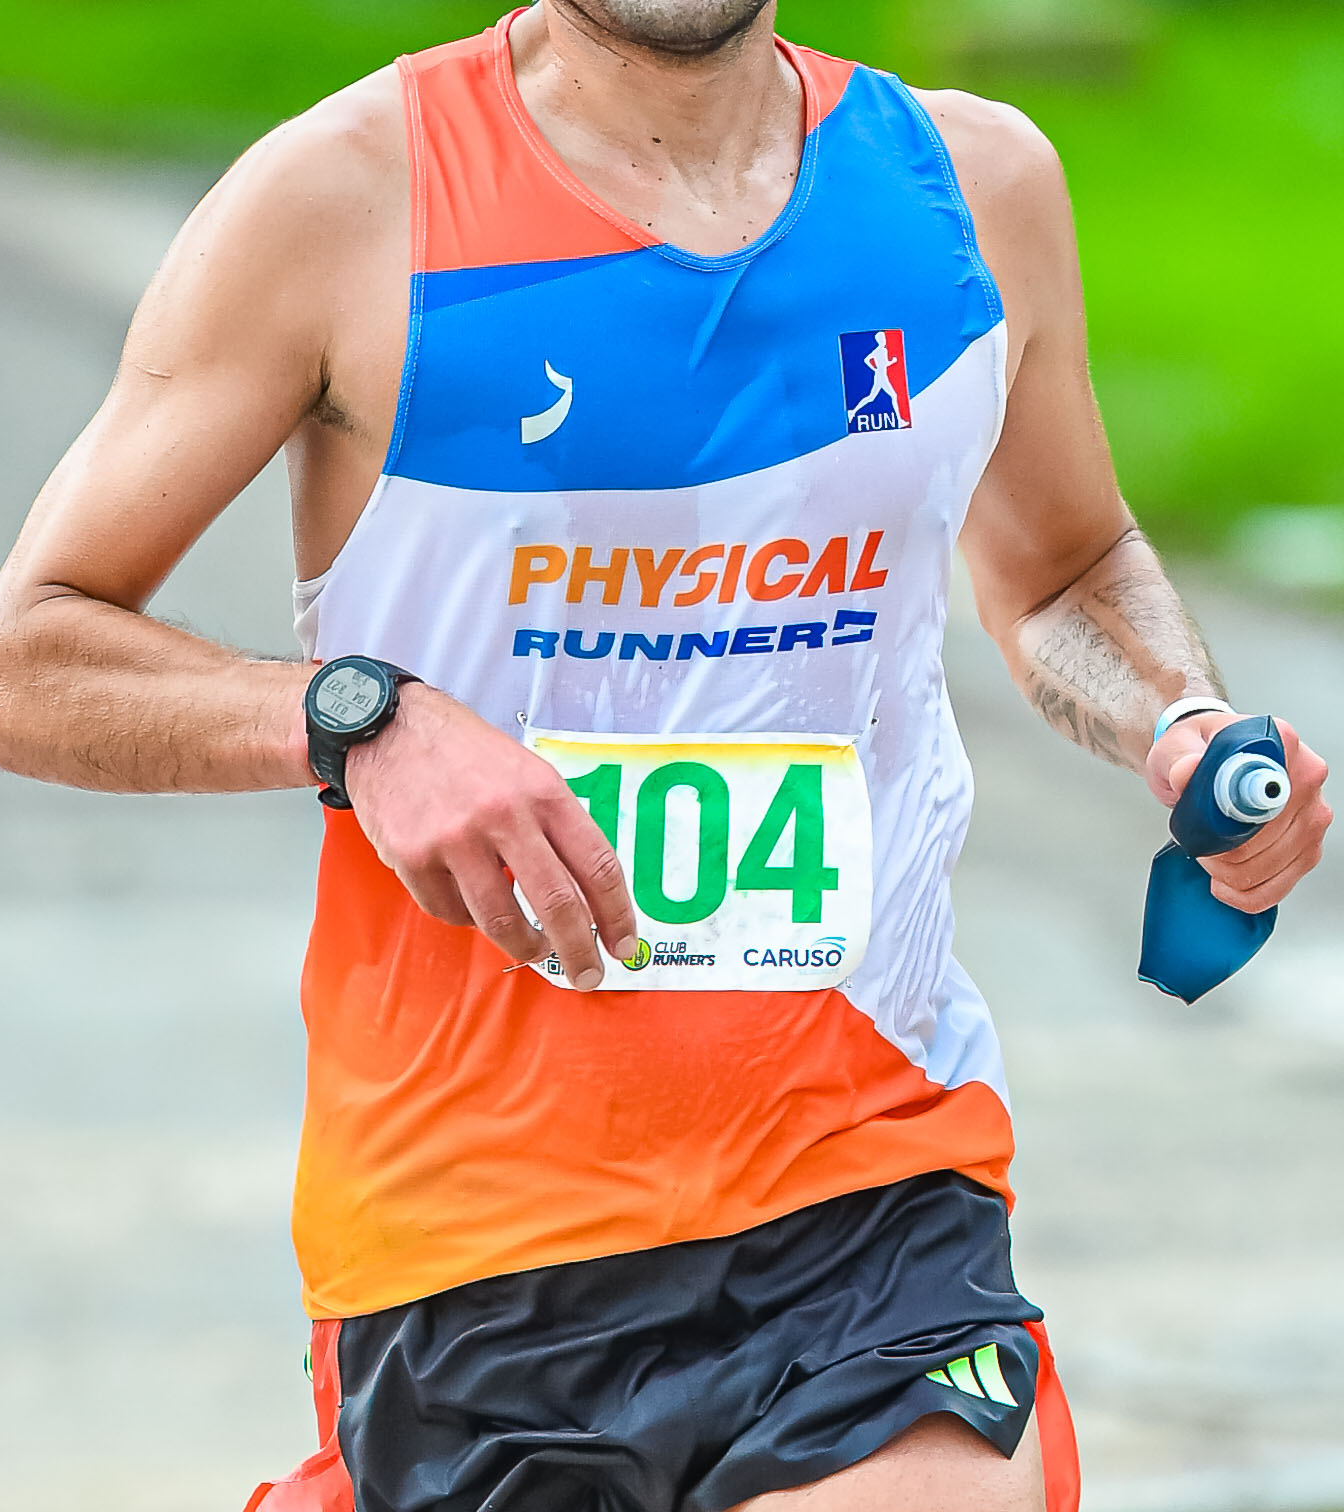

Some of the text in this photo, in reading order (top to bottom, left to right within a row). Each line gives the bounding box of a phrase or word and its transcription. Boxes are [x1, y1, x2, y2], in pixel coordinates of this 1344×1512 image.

[857, 412, 896, 431] RUN
[508, 530, 888, 608] PHYSICAL
[565, 761, 839, 924] 104
[654, 942, 687, 953] CLUB
[652, 954, 715, 966] RUNNER'S
[743, 948, 842, 967] CARUSO
